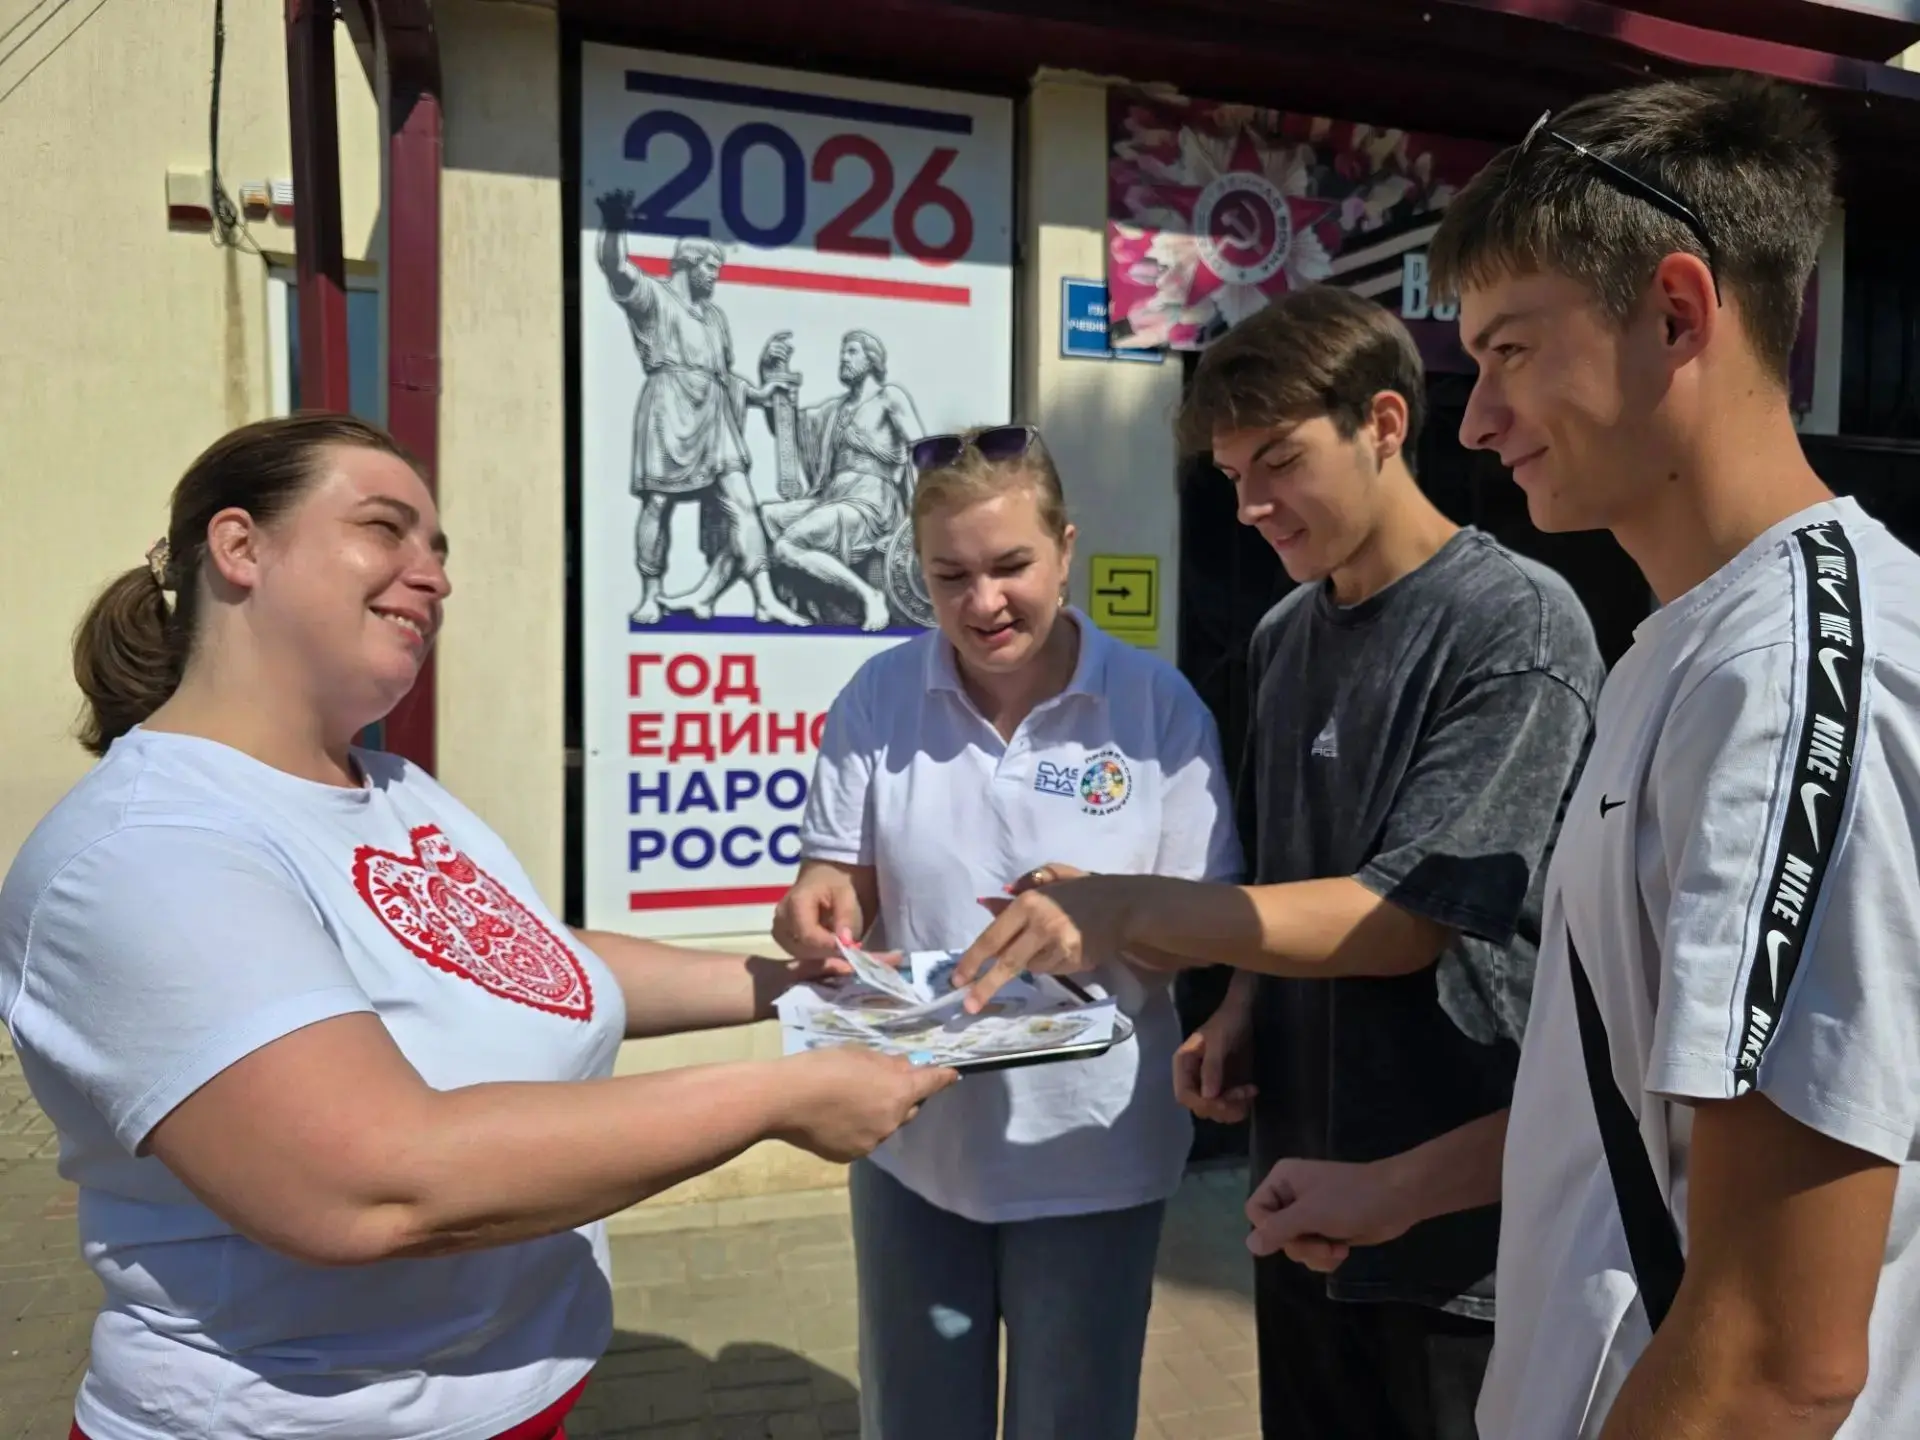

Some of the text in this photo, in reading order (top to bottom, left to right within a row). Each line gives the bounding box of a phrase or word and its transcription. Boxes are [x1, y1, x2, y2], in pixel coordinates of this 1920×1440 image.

[623, 110, 974, 267] 2026
[1819, 612, 1853, 647] NIKE
[628, 653, 761, 705] ГОД
[1806, 713, 1845, 782] NIKE
[628, 768, 808, 815] НАРО
[628, 824, 803, 873] РОСС
[1771, 853, 1814, 927] NIKE
[1740, 1005, 1772, 1070] NIKE
